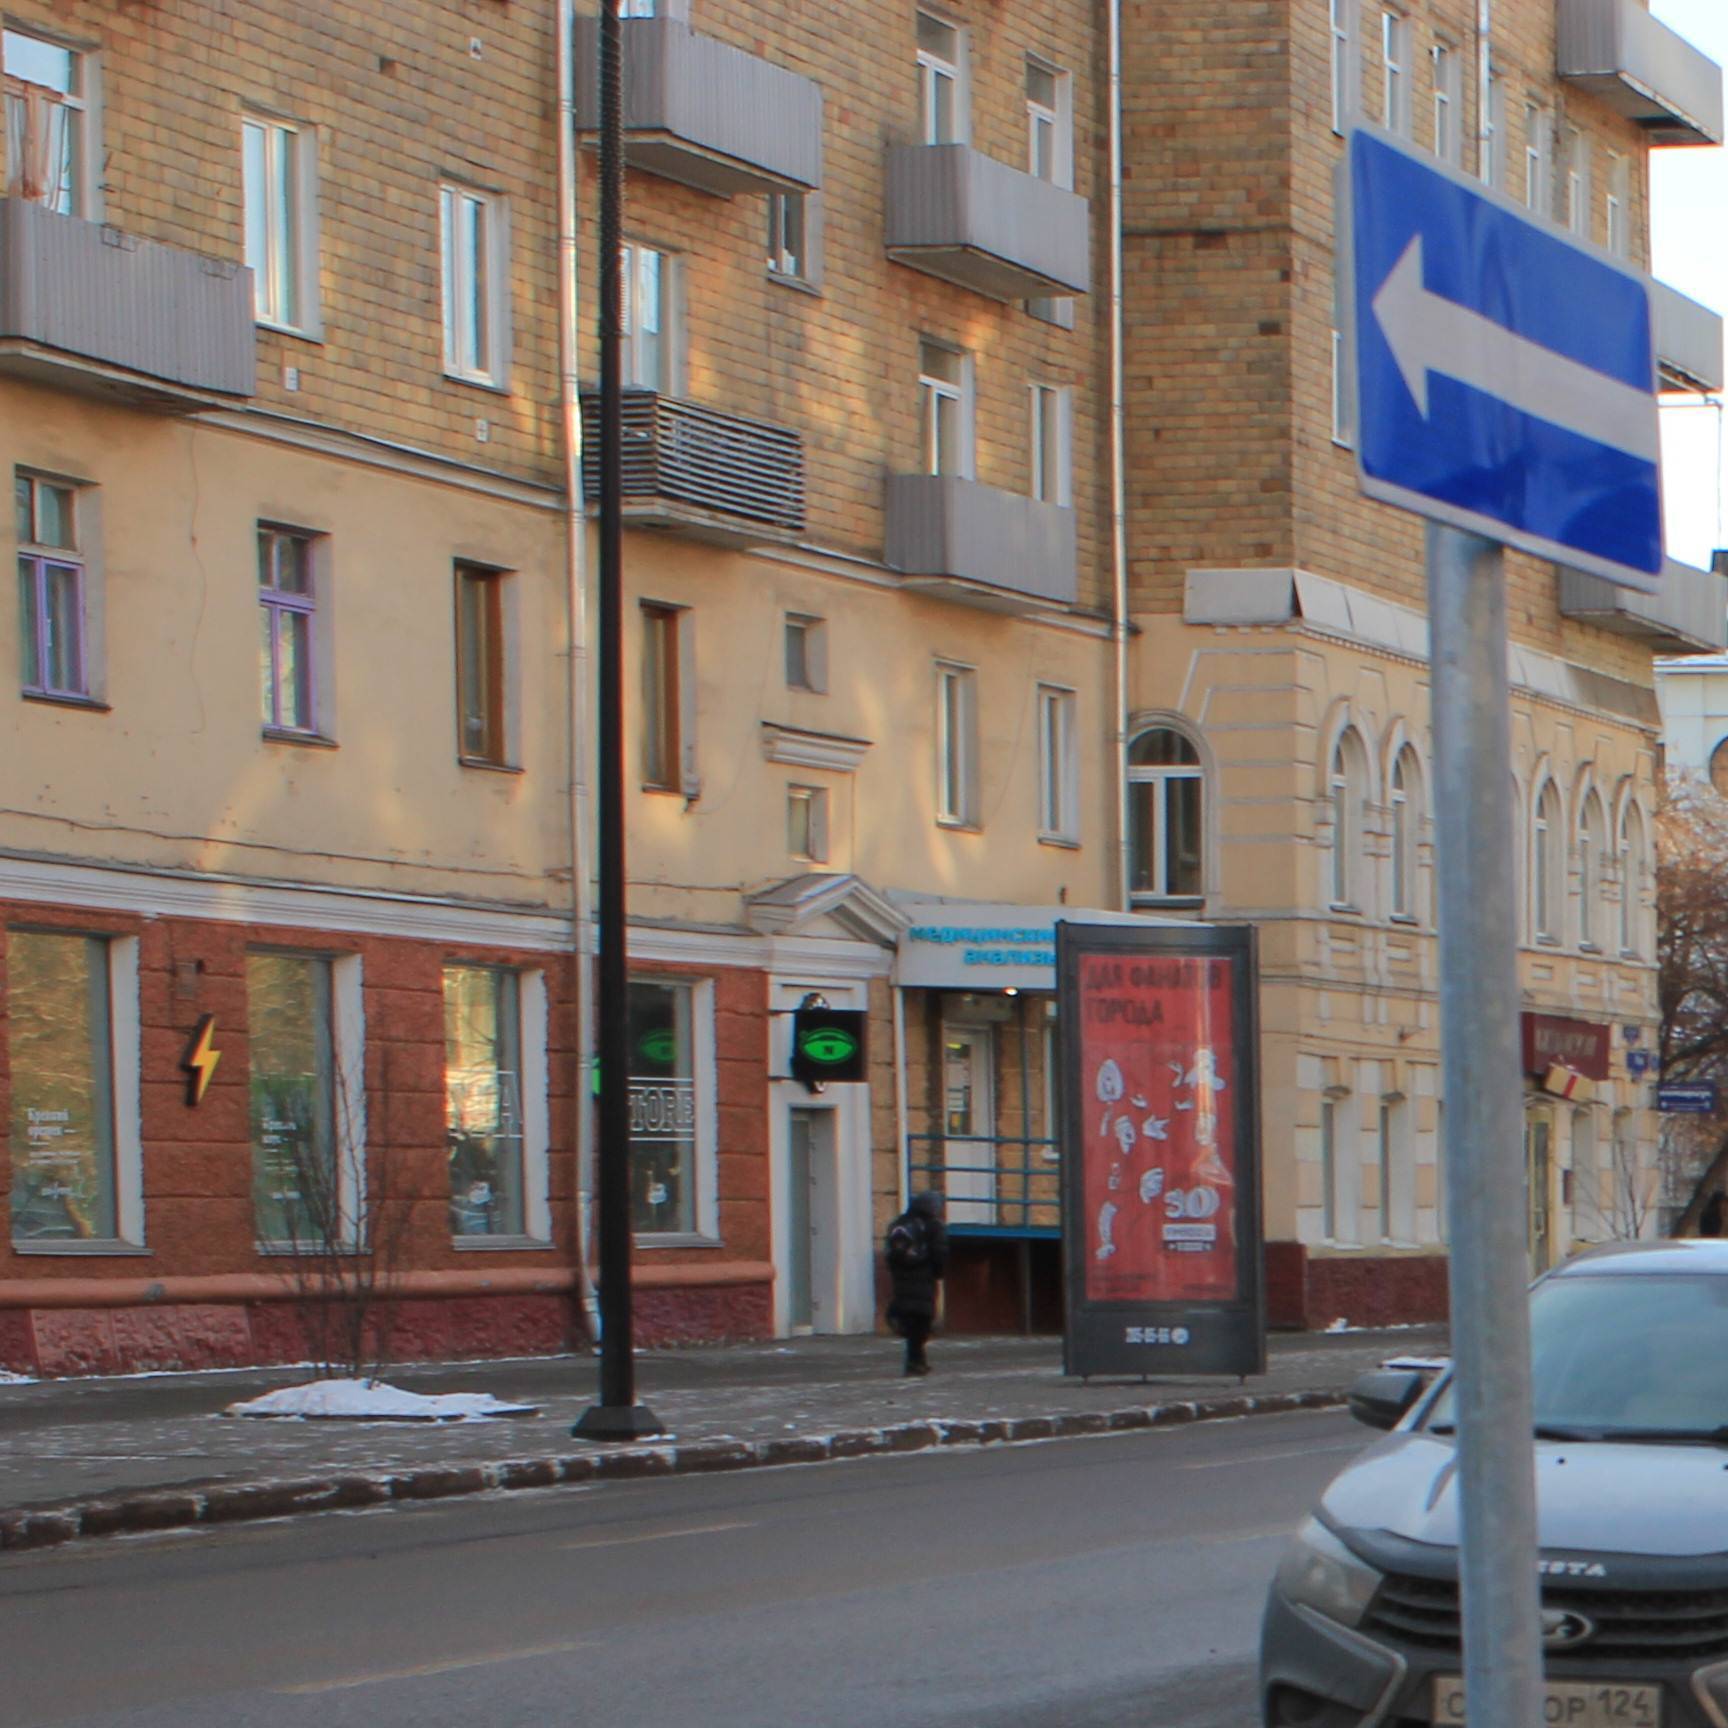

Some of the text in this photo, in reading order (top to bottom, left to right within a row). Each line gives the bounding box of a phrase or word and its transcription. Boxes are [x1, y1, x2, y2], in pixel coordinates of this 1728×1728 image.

[910, 927, 1056, 944] медицински
[1129, 963, 1222, 990] ФАНАТВ
[1598, 1687, 1652, 1719] 124
